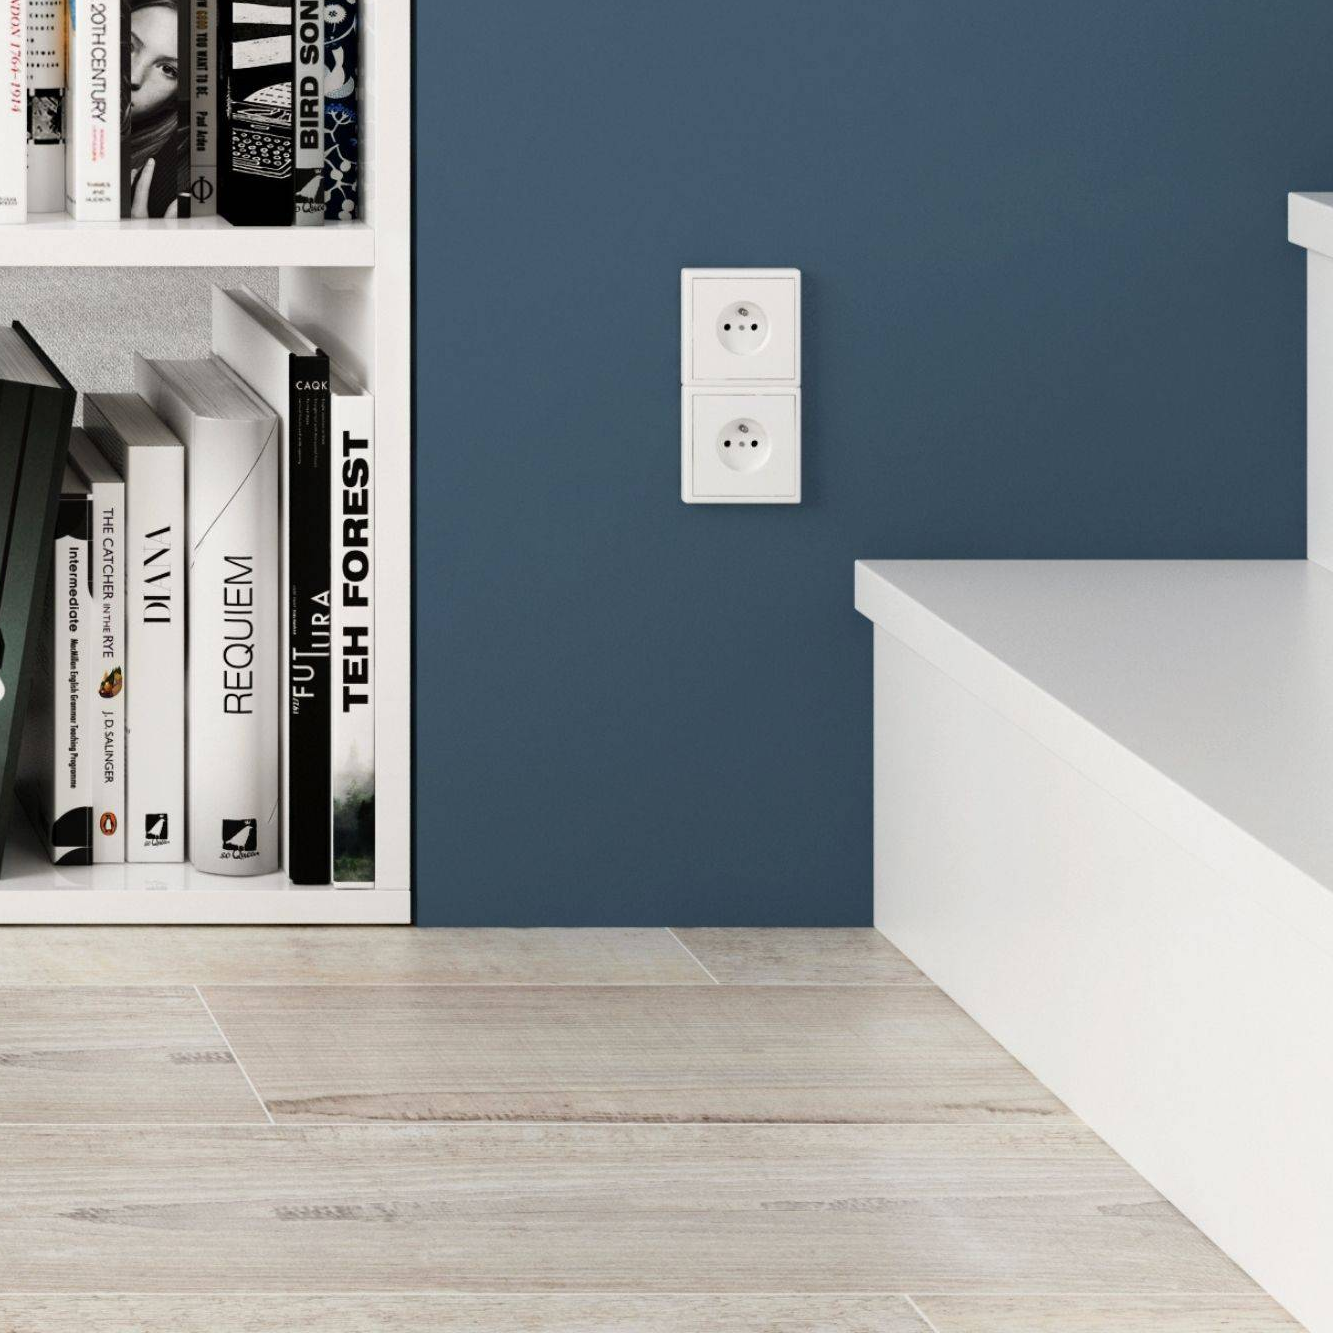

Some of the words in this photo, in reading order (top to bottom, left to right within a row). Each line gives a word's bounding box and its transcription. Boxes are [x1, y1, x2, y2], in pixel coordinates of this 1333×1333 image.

[90, 3, 107, 45] 20TH
[195, 32, 208, 48] YOU
[195, 50, 208, 71] WANT
[195, 73, 208, 83] TO
[90, 47, 107, 123] CENTURY
[195, 110, 208, 127] Paul
[299, 76, 319, 149] BIRD
[195, 129, 208, 152] Arden
[102, 507, 114, 534] THE
[341, 430, 370, 608] FOREST
[102, 537, 114, 600] CATCHER
[142, 524, 172, 625] DIANA
[68, 546, 80, 633] Intermediate
[102, 635, 114, 658] RYE
[223, 555, 254, 715] REQUIEM
[68, 670, 79, 694] English
[342, 626, 369, 714] TEH
[69, 694, 79, 724] Grammar
[68, 752, 79, 789] Programme
[104, 732, 114, 784] SALINGER
